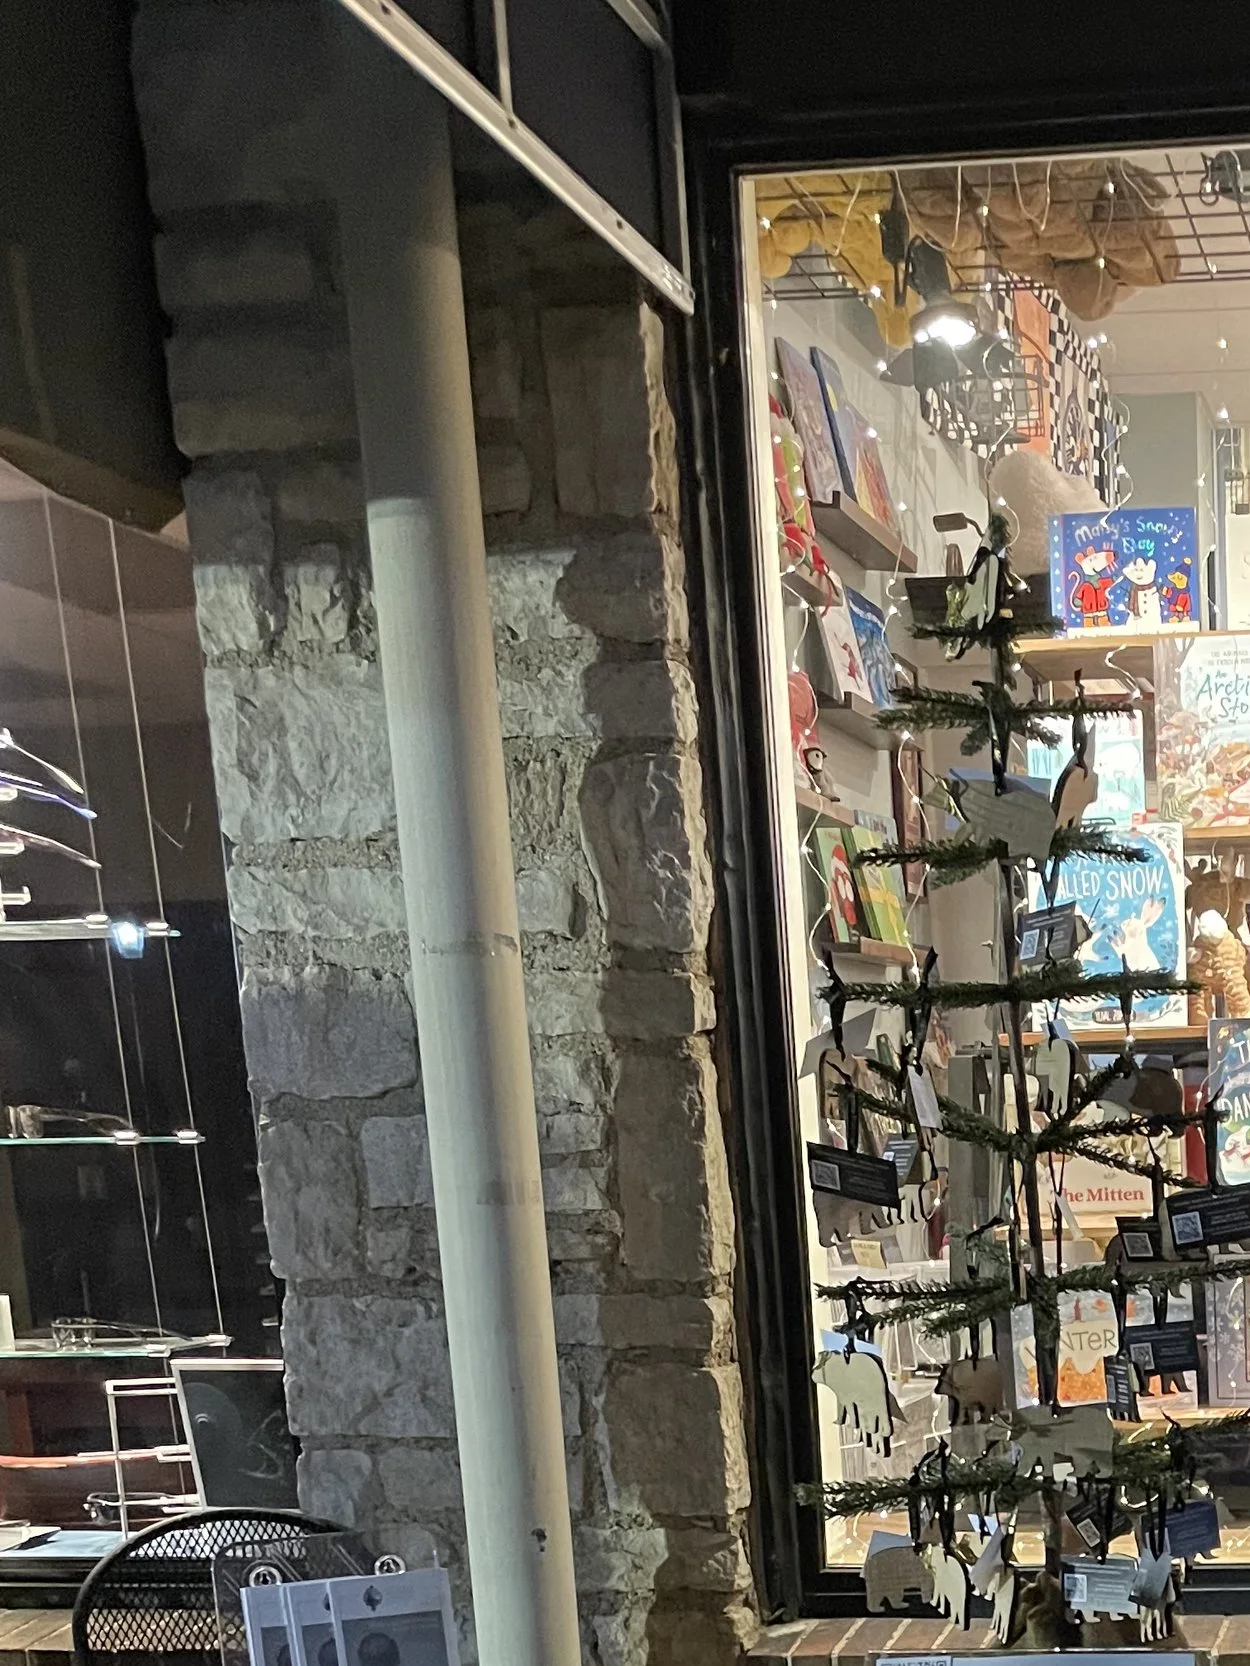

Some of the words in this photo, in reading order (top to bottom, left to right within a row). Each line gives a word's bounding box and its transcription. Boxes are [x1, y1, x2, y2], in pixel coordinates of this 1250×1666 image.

[1055, 868, 1101, 900] ALLED
[1106, 864, 1165, 901] SNOW
[1087, 1186, 1145, 1203] Mitten
